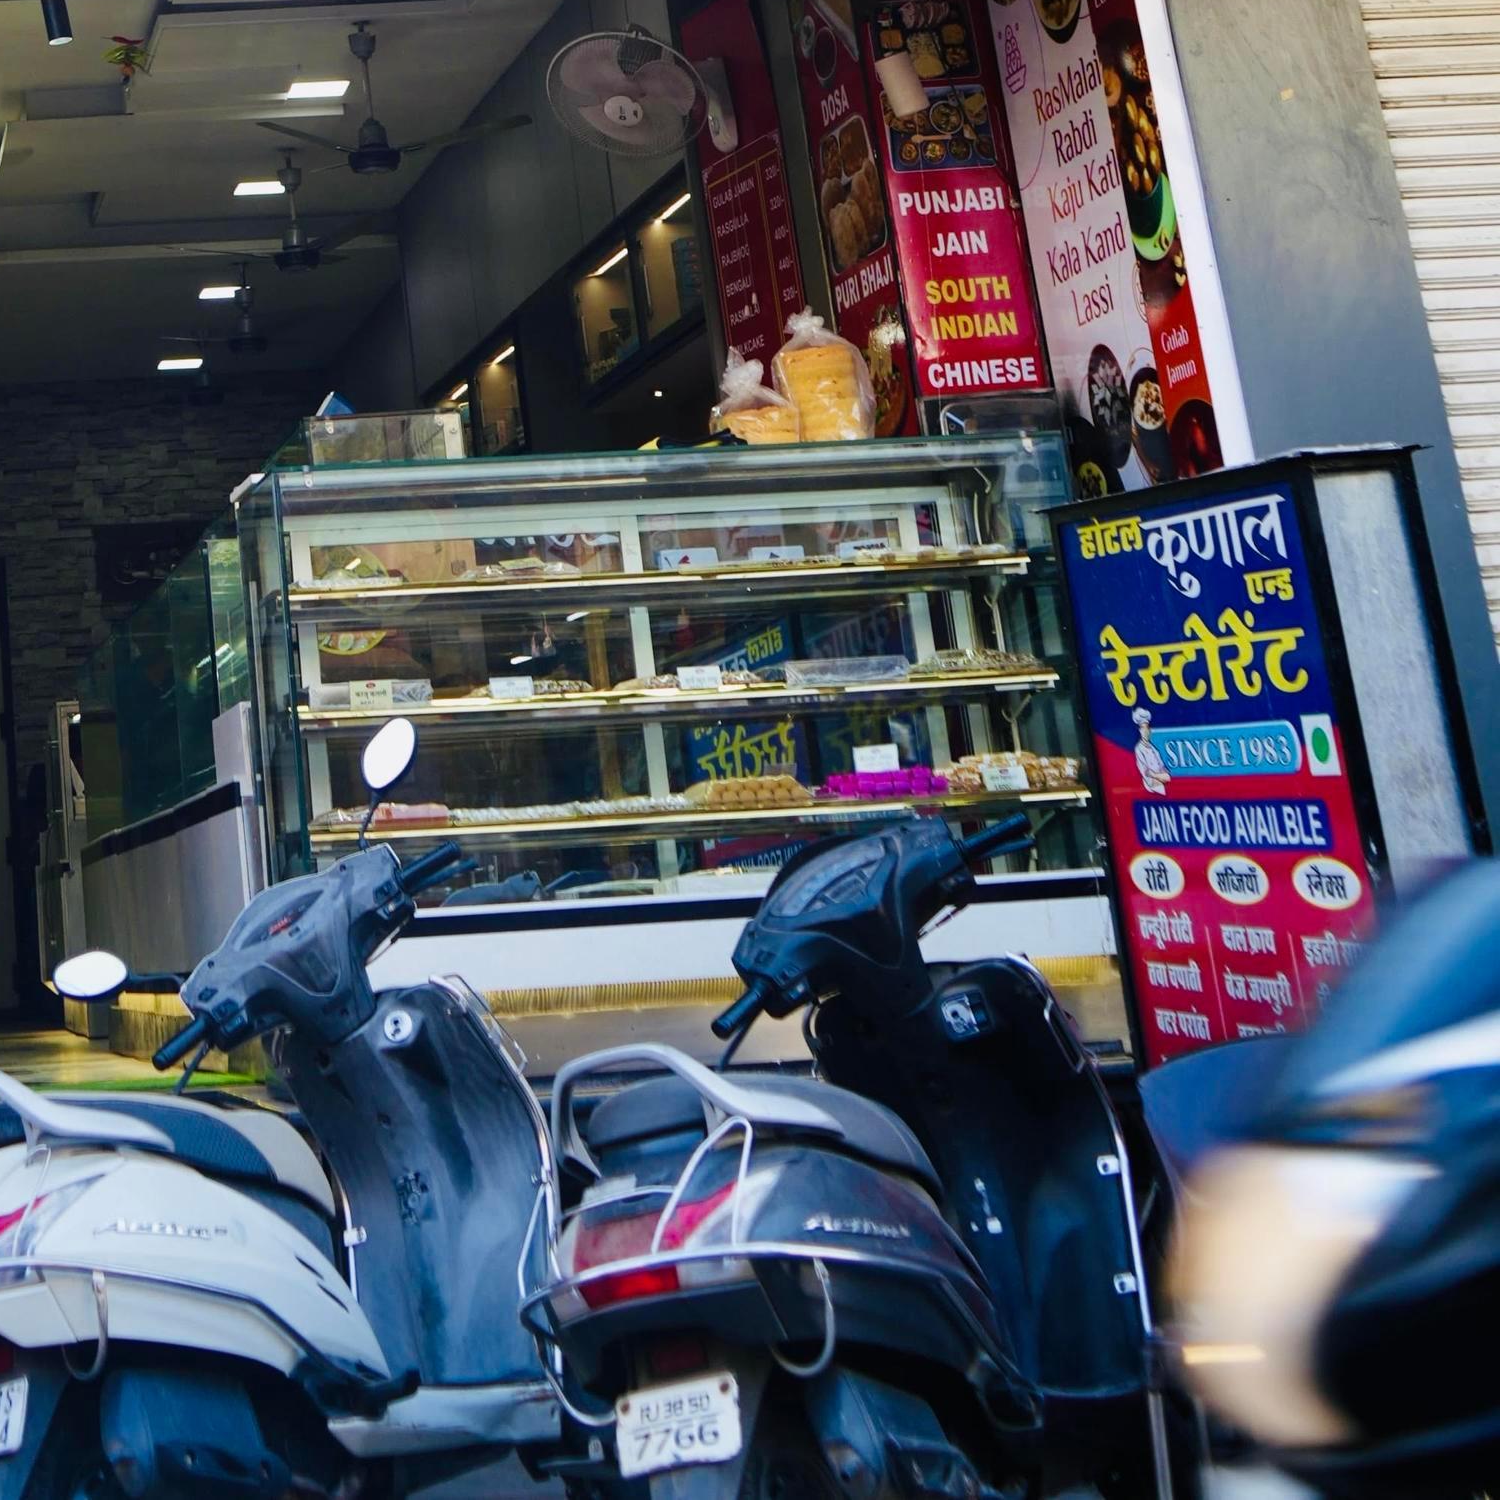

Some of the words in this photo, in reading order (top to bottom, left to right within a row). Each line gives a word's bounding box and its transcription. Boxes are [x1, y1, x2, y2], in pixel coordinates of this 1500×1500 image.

[819, 85, 850, 128] DOSA
[1032, 49, 1102, 126] RasMalai
[1052, 108, 1099, 168] Rabdi
[712, 185, 733, 210] GULAB
[898, 187, 1005, 217] PUNJABI
[1047, 174, 1085, 225] Kaju
[931, 229, 989, 257] JAIN
[1046, 239, 1082, 289] Kala
[1081, 211, 1127, 267] Kand
[833, 270, 862, 315] PURI
[861, 254, 894, 300] BHAJI
[925, 275, 1011, 305] SOUTH
[1071, 274, 1114, 329] Lassi
[930, 311, 1019, 341] INDIAN
[1160, 324, 1190, 356] Gulab
[927, 357, 1038, 389] CHINESE
[1166, 357, 1198, 389] Jamun
[1077, 515, 1144, 560] होटल
[1140, 493, 1289, 598] कुणाल
[1243, 568, 1295, 604] एन्ड
[1099, 607, 1310, 708] रेस्टोरेंट
[1164, 739, 1236, 769] SINCE
[1238, 733, 1293, 766] 1983
[1141, 805, 1179, 844] JAIN
[1181, 804, 1232, 845] FOOD
[1234, 804, 1327, 847] AVAILBLE
[1143, 859, 1172, 893] रोटी
[633, 1419, 720, 1462] 7766
